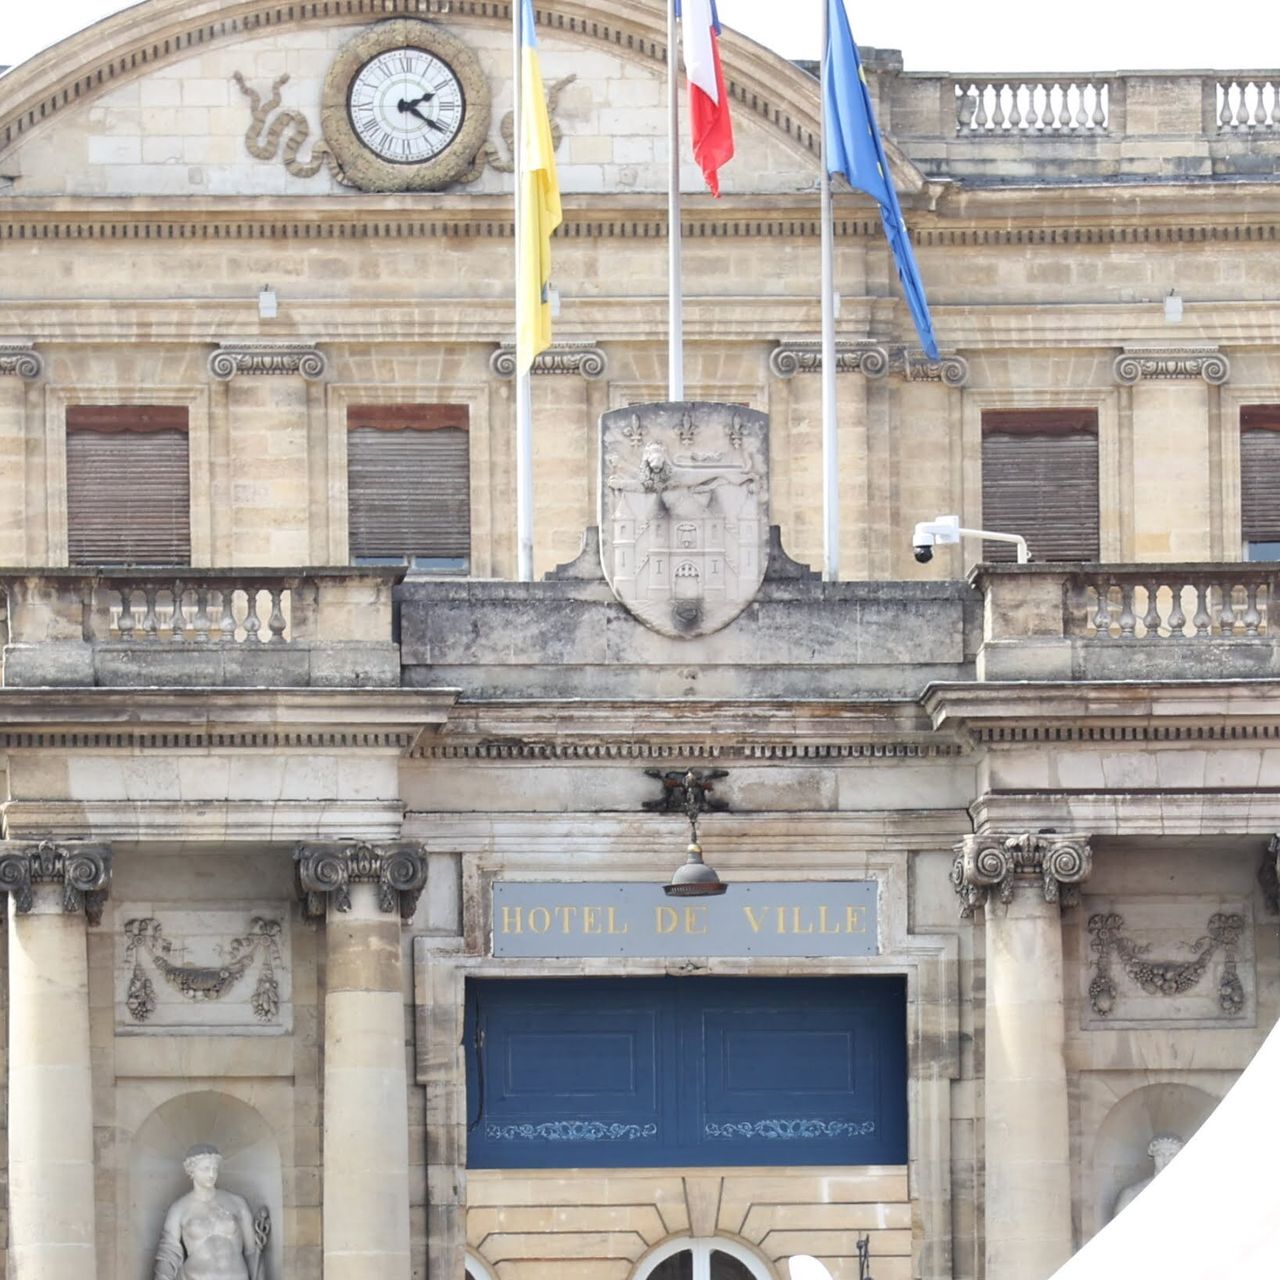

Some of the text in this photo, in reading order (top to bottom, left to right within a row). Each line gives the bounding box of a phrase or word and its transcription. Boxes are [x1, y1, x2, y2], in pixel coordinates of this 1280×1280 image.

[501, 904, 868, 935] HOTEL DE VILLE
